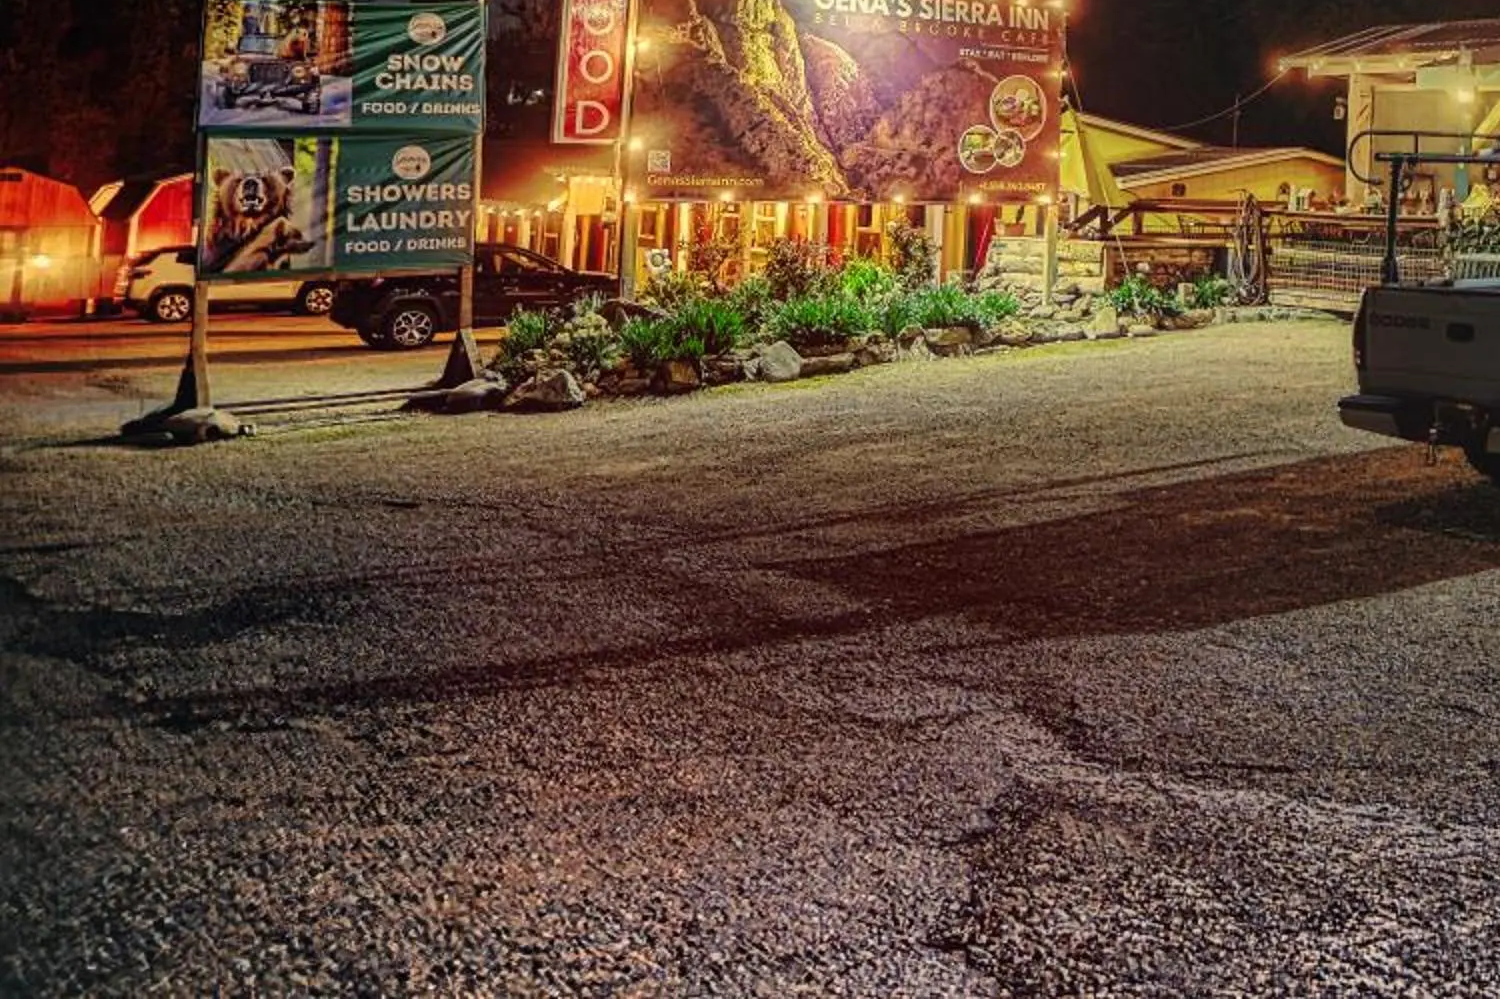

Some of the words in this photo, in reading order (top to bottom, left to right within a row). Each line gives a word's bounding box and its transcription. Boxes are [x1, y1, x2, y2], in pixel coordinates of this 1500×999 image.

[1008, 4, 1049, 31] INN
[387, 54, 465, 72] SNOW
[375, 72, 474, 90] CHAINS
[361, 102, 407, 114] FOOD
[422, 102, 481, 114] DRINKS
[347, 183, 472, 203] SHOWERS
[347, 210, 471, 233] LAUNDRY
[345, 240, 391, 254] FOOD
[406, 236, 467, 251] DRINKS
